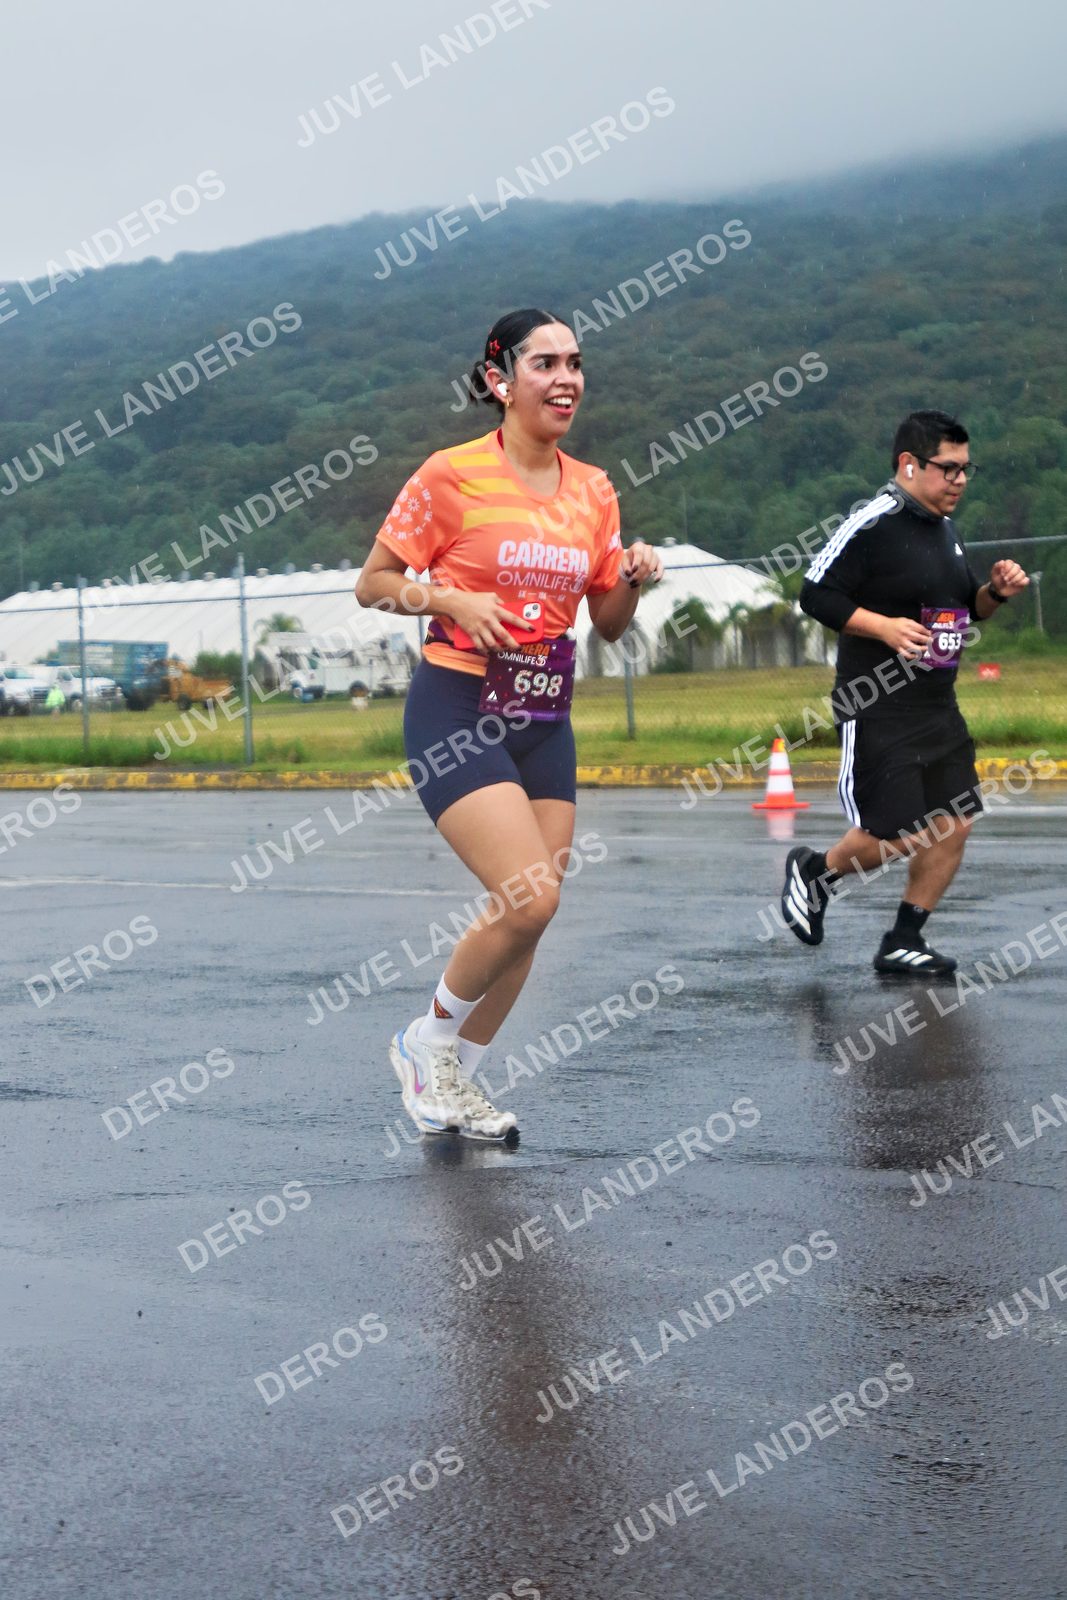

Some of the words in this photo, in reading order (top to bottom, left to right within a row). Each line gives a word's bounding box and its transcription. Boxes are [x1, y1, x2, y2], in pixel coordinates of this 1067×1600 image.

[497, 540, 590, 576] CARRERA
[496, 569, 570, 591] OMNILIFE
[514, 670, 563, 697] 698
